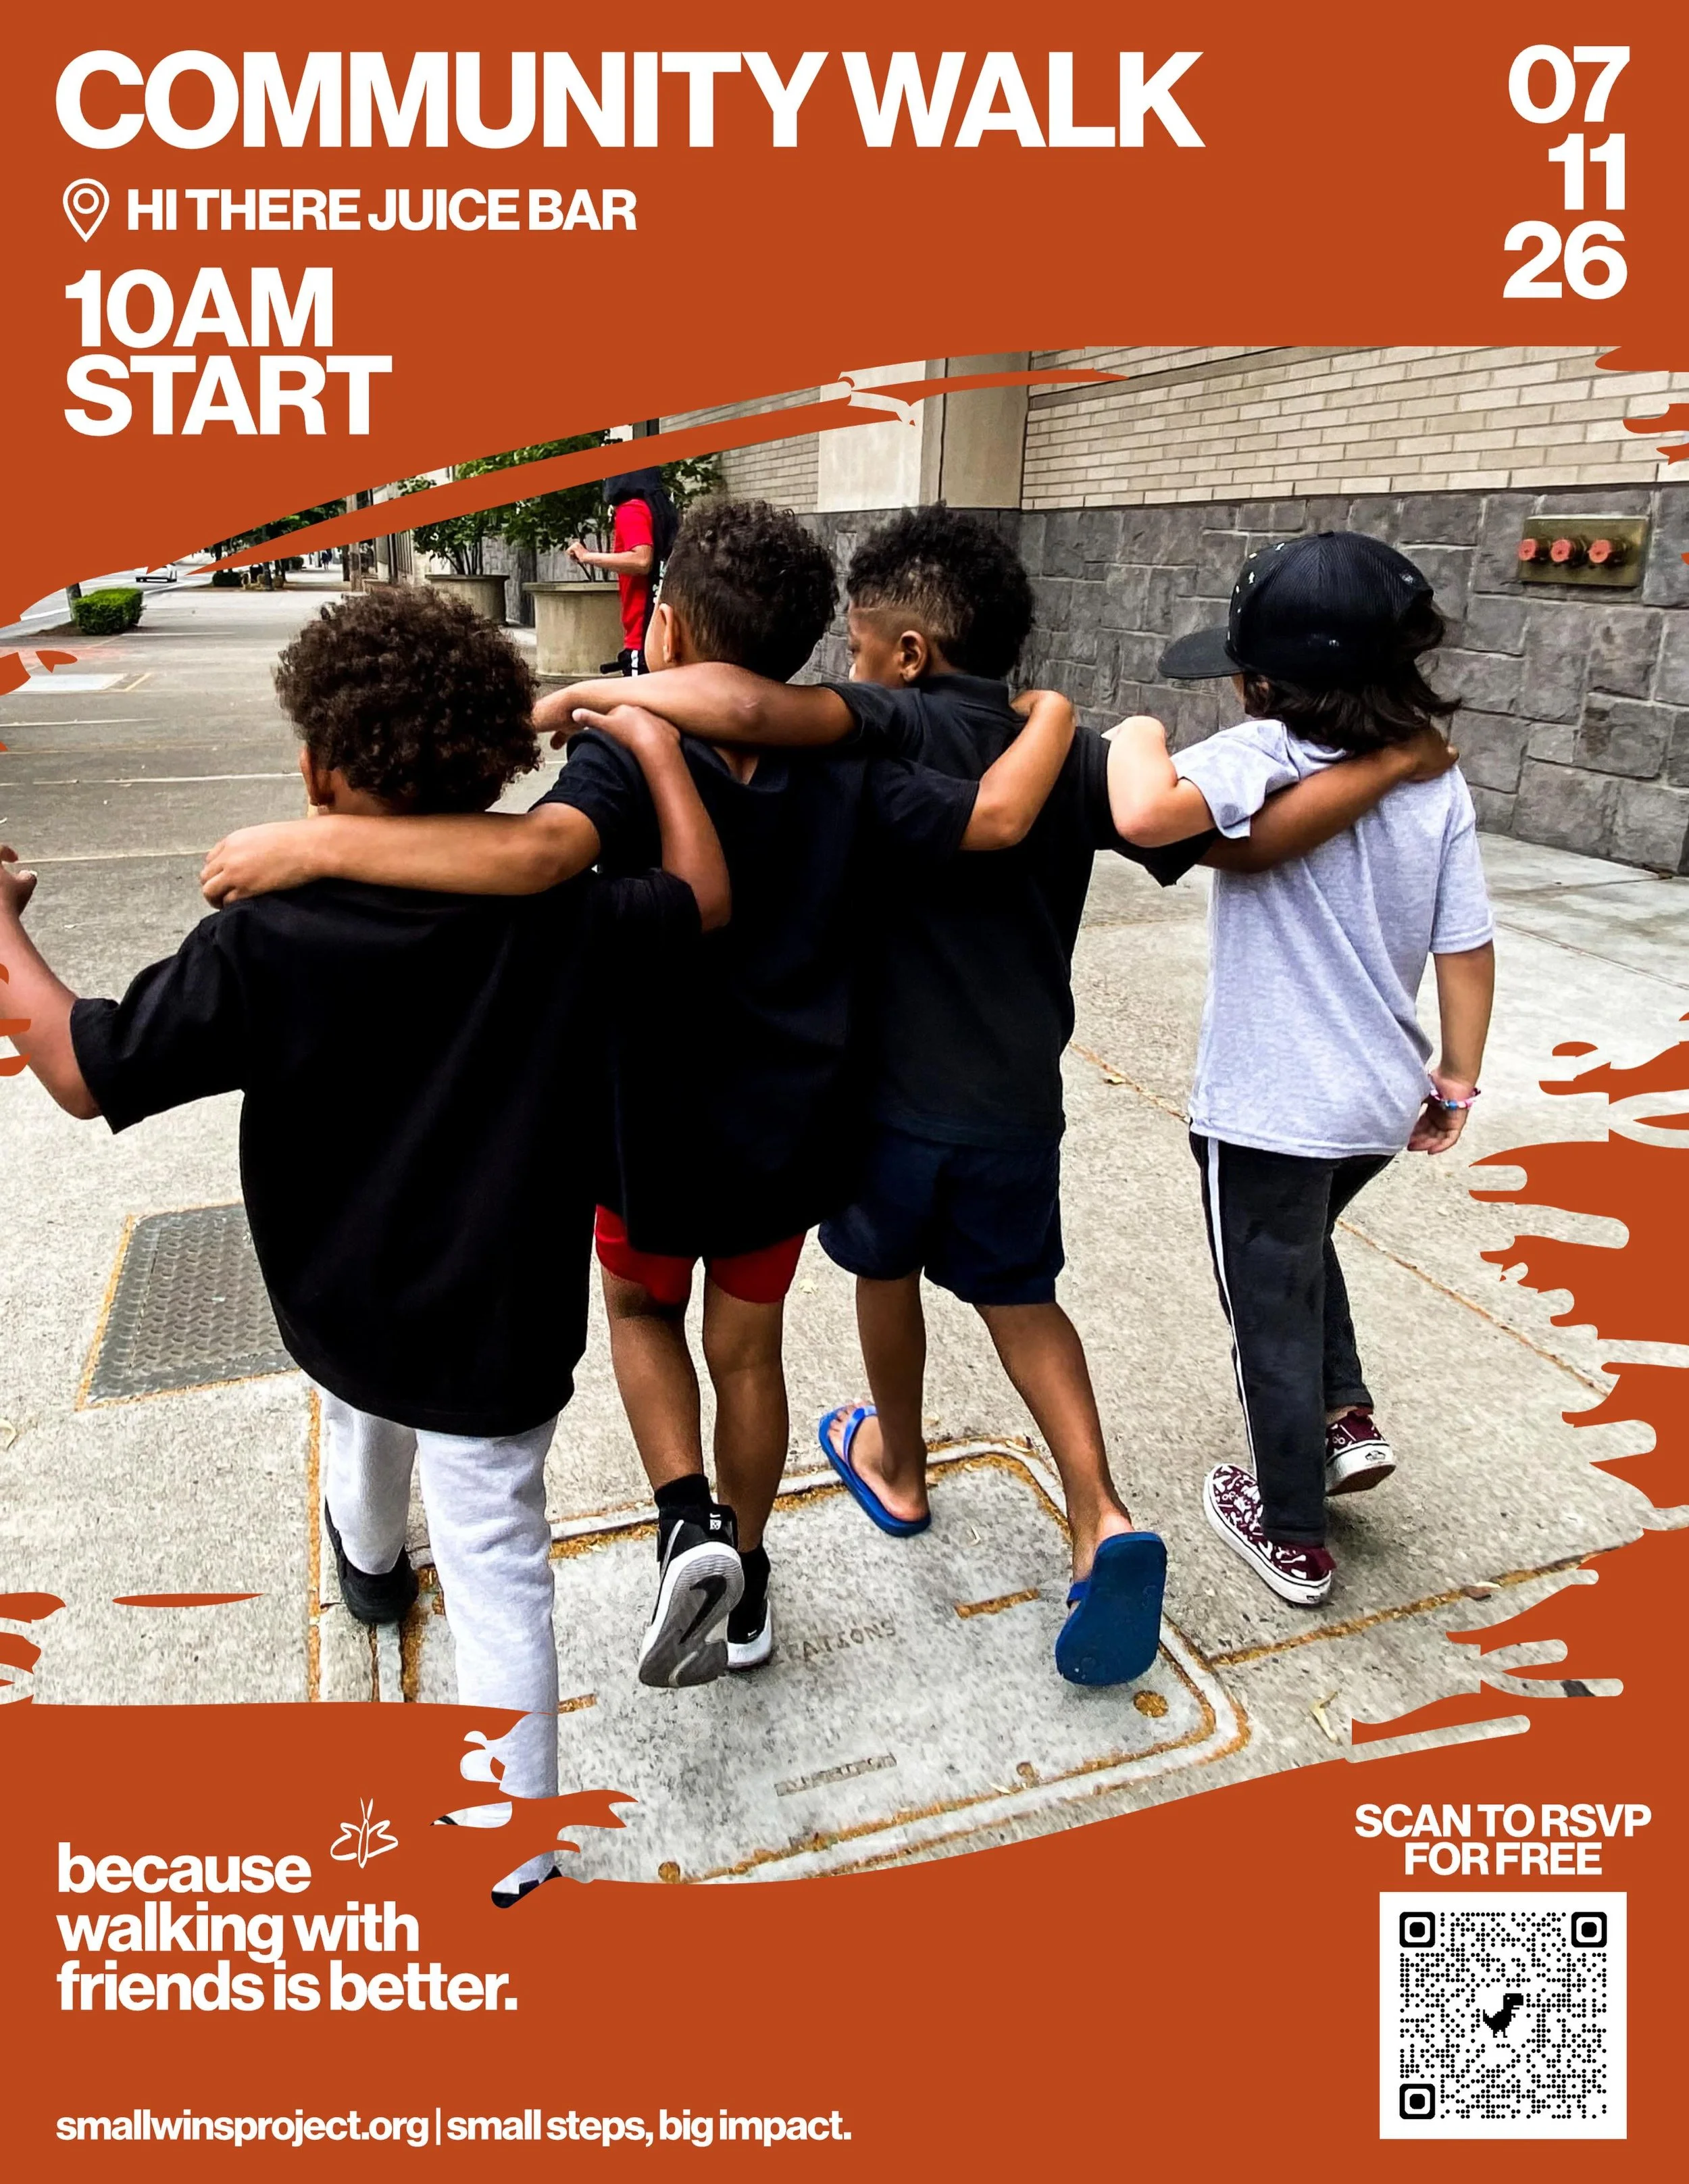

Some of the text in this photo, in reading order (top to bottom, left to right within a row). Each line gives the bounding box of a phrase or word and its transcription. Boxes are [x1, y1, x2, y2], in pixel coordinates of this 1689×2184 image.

[56, 50, 1205, 149] COMMUNITY WALK
[1509, 45, 1630, 123] 07
[1548, 134, 1625, 209] 11
[128, 189, 636, 230] HI THERE JUICE BAR
[1503, 221, 1627, 299] 26
[66, 268, 332, 348] 10AM
[65, 354, 392, 436] START
[1355, 1804, 1651, 1838] SCAN TO RSVP
[59, 1842, 311, 1893] because
[1405, 1842, 1602, 1875] FOR FREE
[56, 1902, 418, 1969] walking with
[57, 1960, 517, 2011] friends is better.
[57, 2110, 428, 2147] smallwinsproject.org
[447, 2110, 540, 2140] small
[547, 2111, 653, 2147] steps,
[660, 2110, 713, 2147] big
[720, 2110, 851, 2146] impact.
